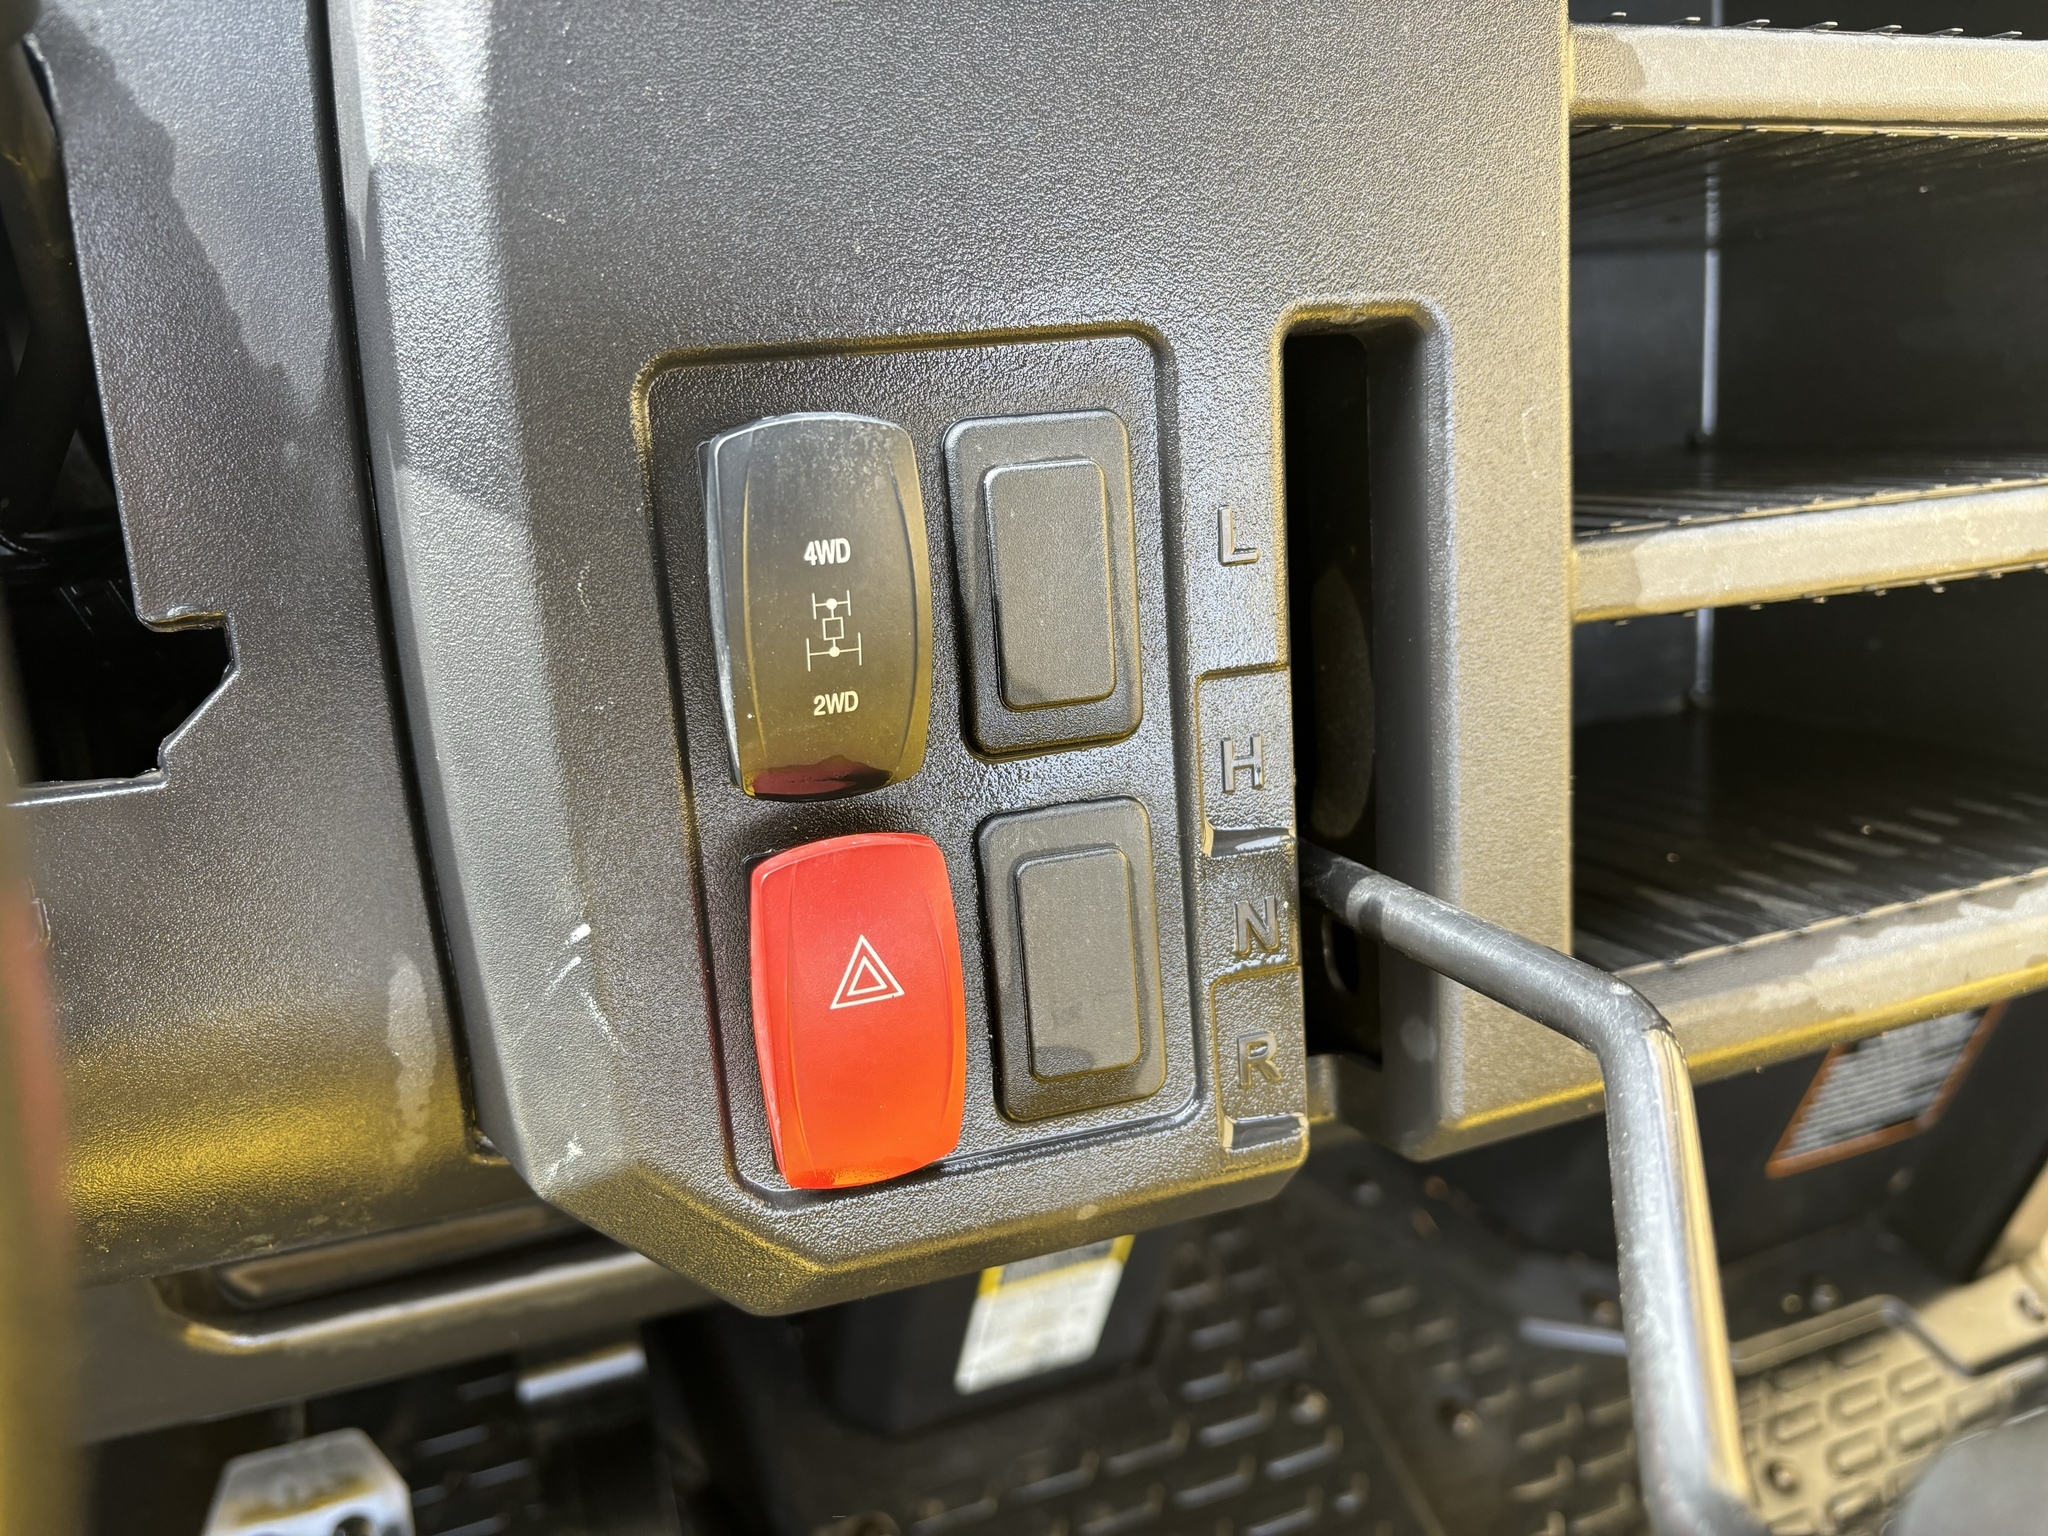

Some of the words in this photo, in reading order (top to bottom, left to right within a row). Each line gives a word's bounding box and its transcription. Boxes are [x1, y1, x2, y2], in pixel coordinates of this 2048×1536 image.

[804, 538, 851, 566] 4WD
[1218, 505, 1260, 567] L
[813, 690, 859, 716] 2WD
[1220, 733, 1264, 794] H
[1235, 895, 1280, 955] N
[1237, 1031, 1282, 1088] R
